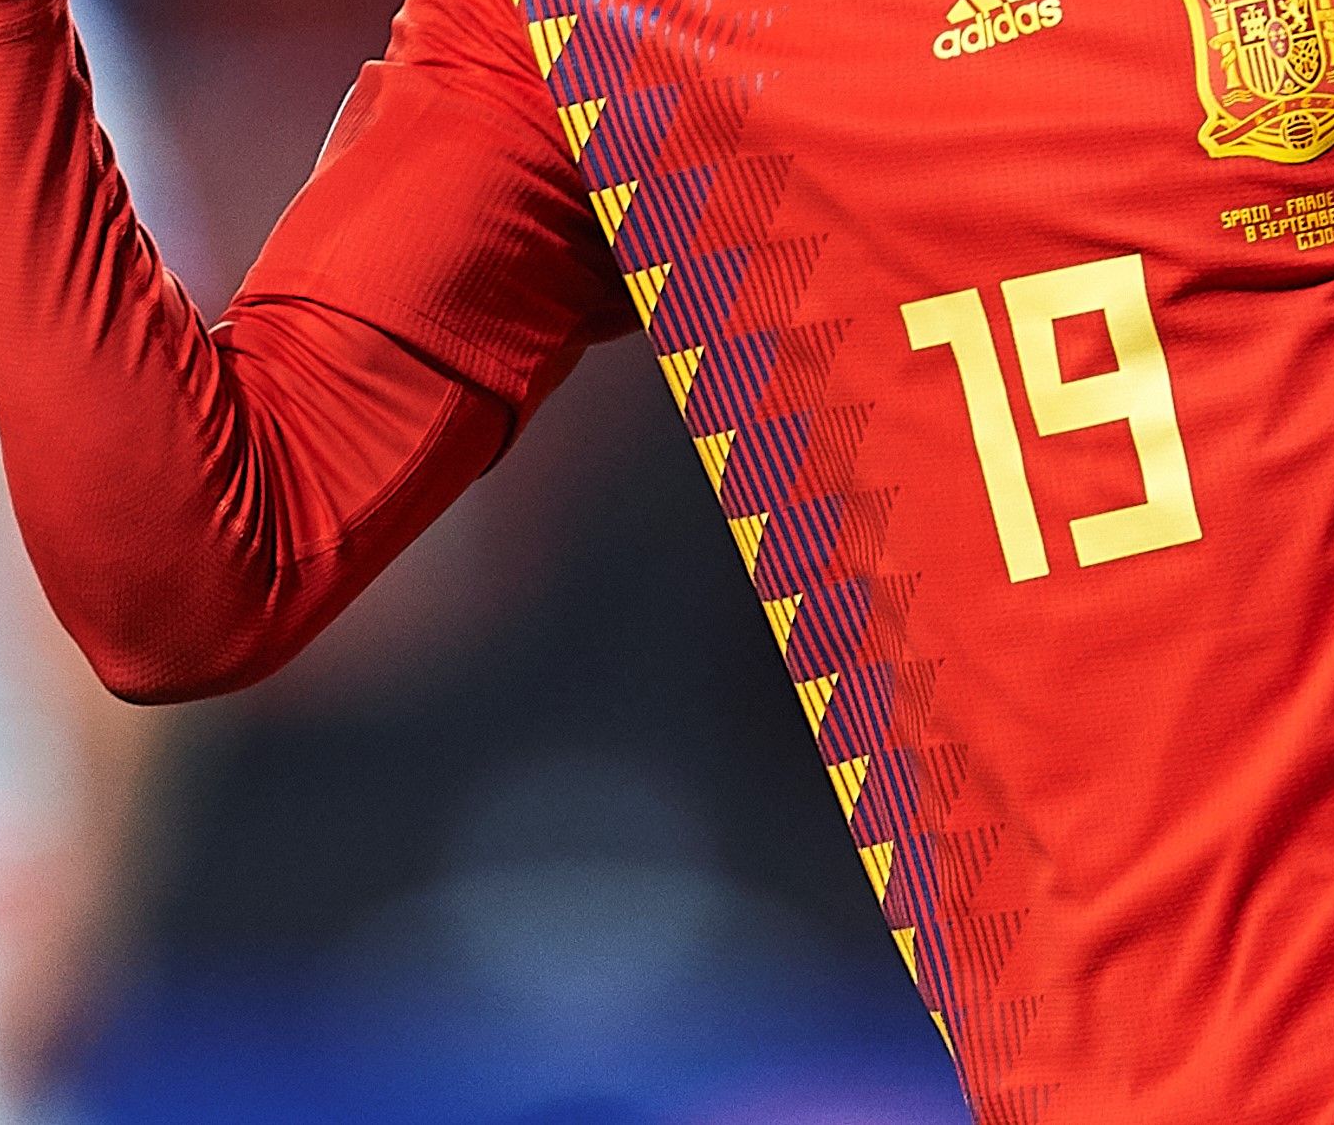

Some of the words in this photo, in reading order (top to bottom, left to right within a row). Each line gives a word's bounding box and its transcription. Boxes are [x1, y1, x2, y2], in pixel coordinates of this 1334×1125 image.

[1220, 204, 1271, 229] SPAIN
[1244, 225, 1258, 243] 8
[899, 252, 1203, 584] 19
